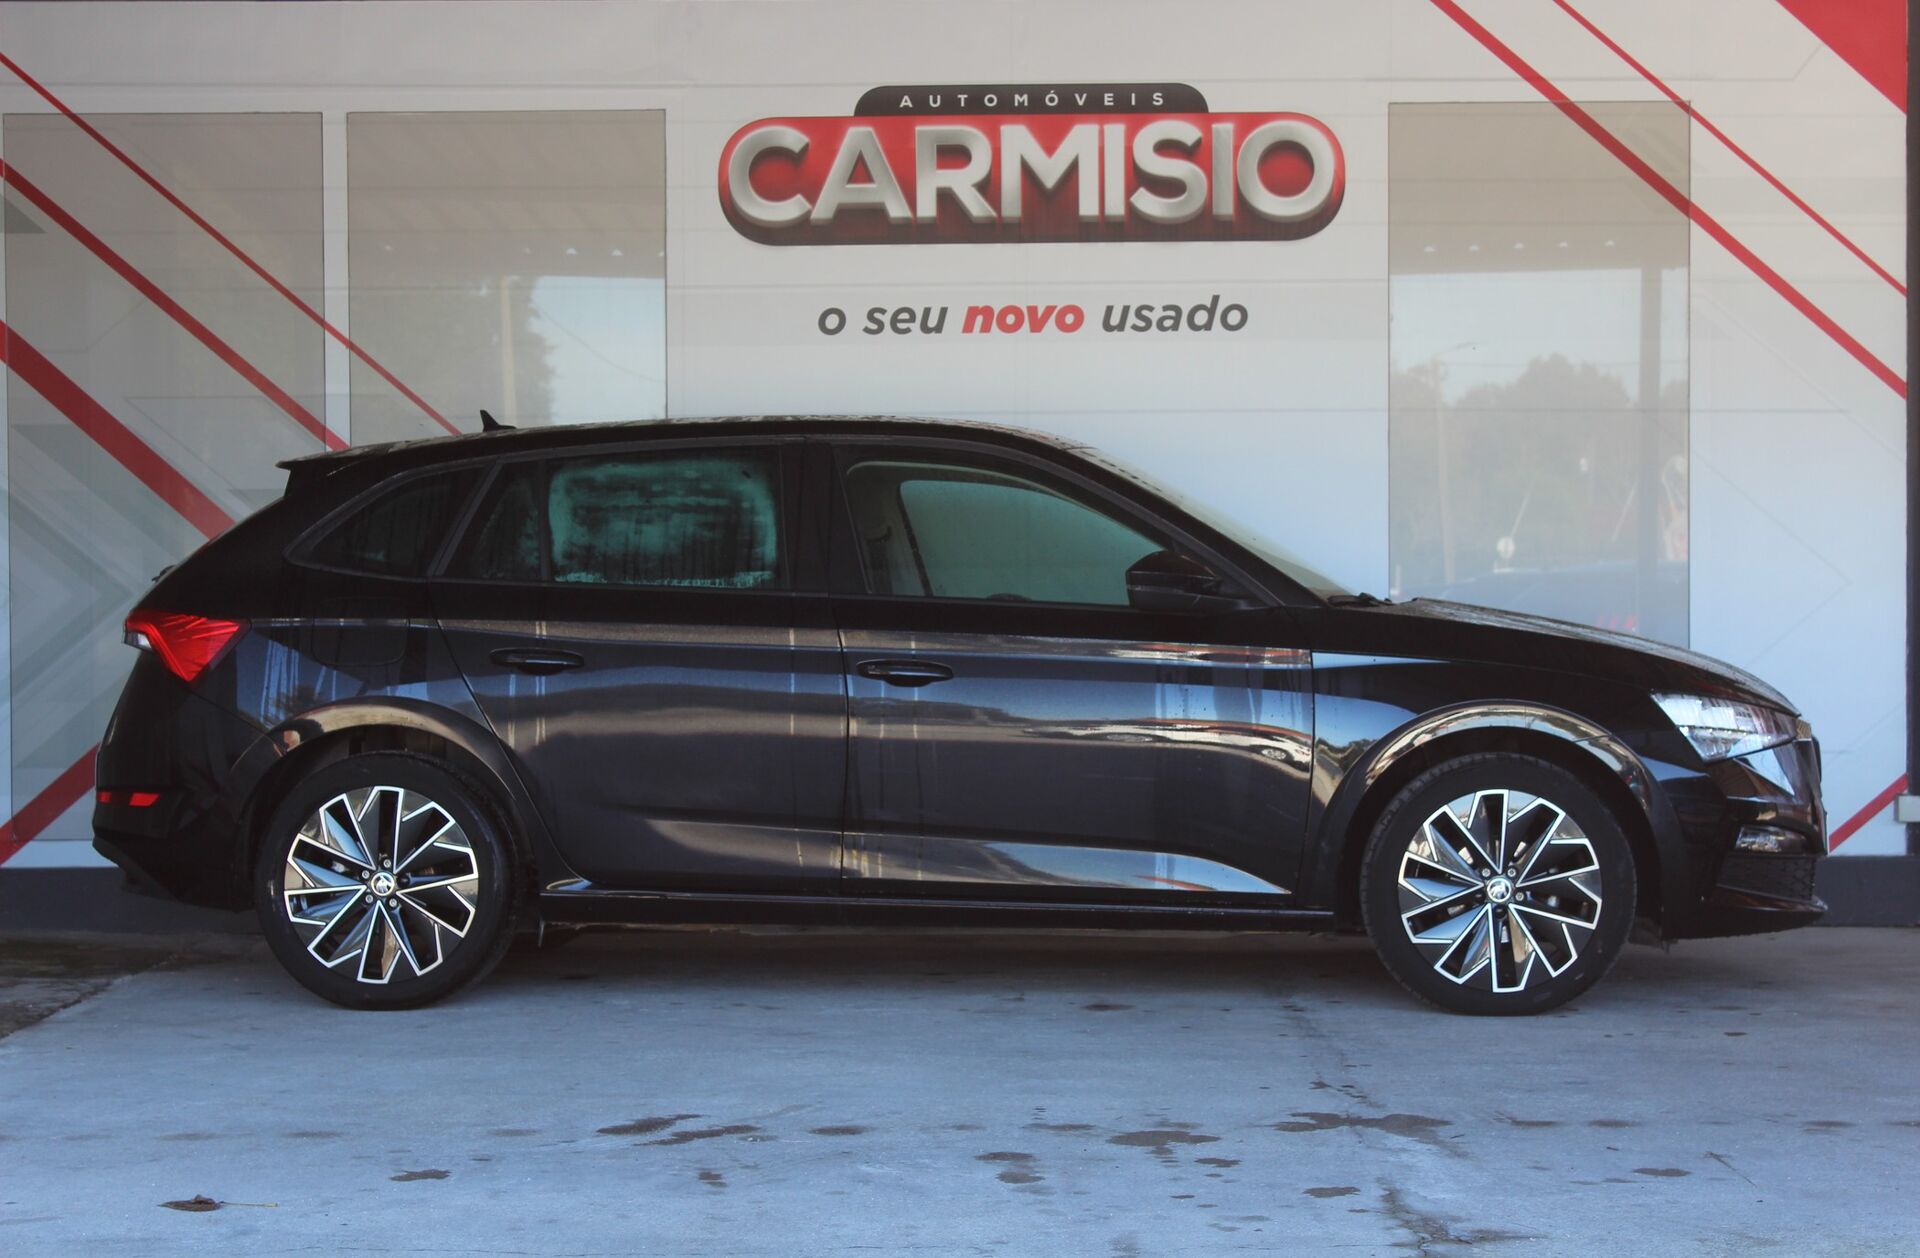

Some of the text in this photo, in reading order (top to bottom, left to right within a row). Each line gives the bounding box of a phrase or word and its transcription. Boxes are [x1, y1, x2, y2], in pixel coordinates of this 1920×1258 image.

[900, 90, 1165, 108] AUTOMÓVEIS
[729, 120, 1336, 225] CARMISIO
[817, 294, 1249, 335] o seu novo usado
